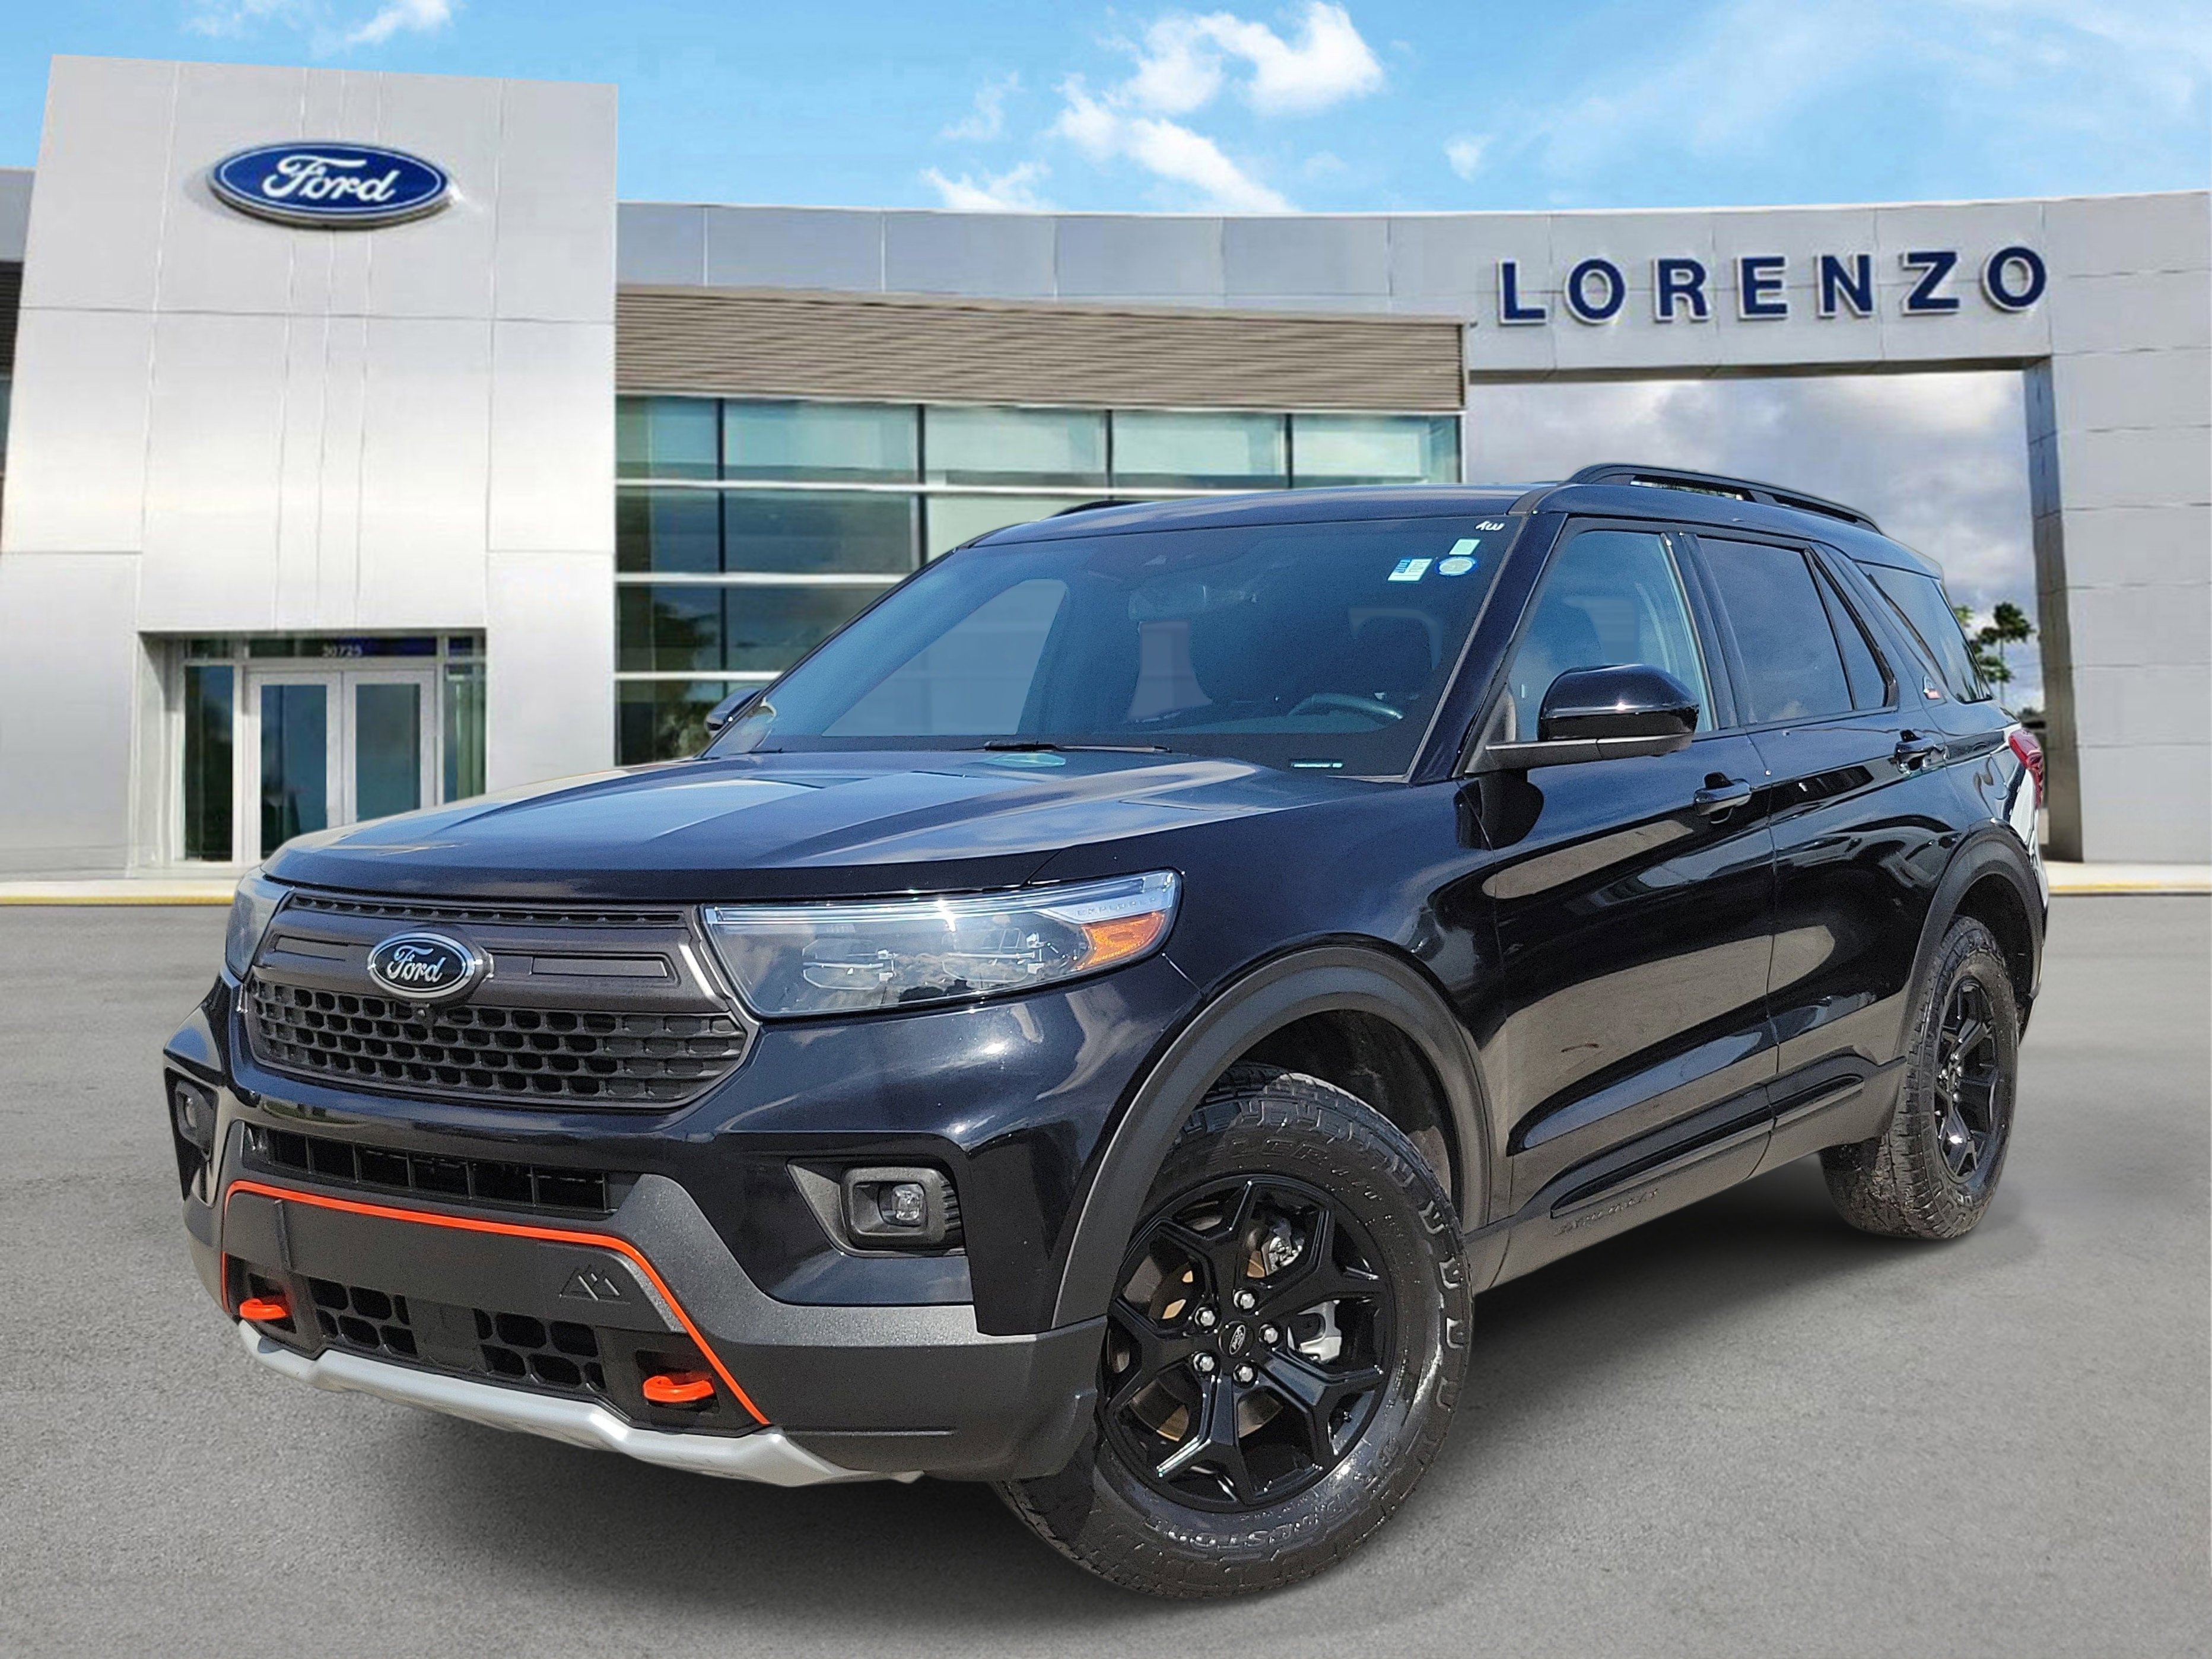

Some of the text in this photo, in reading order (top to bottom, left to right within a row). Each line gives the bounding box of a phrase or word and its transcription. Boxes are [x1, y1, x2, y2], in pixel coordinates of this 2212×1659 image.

[262, 154, 401, 202] Ford
[1497, 245, 2048, 325] LORENZO
[387, 945, 447, 983] Ford
